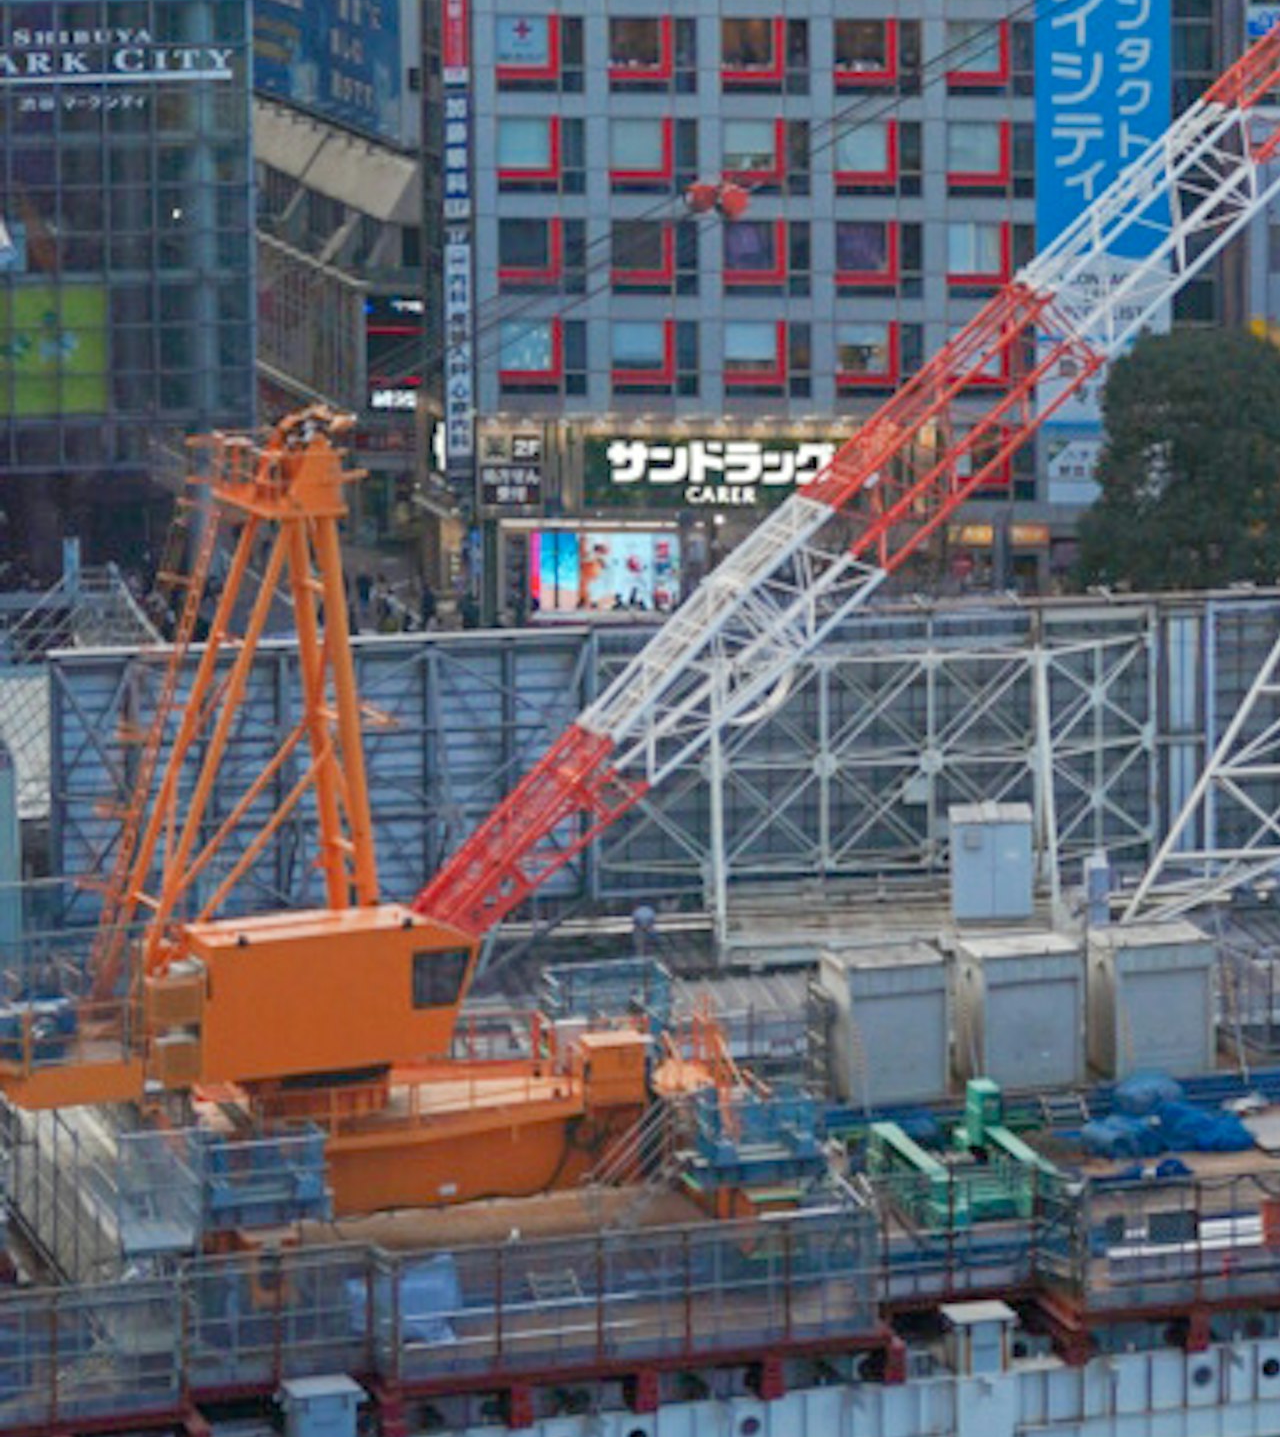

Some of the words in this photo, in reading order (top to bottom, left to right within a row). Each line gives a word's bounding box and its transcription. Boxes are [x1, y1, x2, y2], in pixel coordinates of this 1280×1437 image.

[13, 29, 152, 46] SHIBUYA
[113, 48, 233, 72] CITY
[511, 437, 541, 457] 2F
[606, 439, 837, 485] サンドラッグ
[685, 485, 757, 504] CARER
